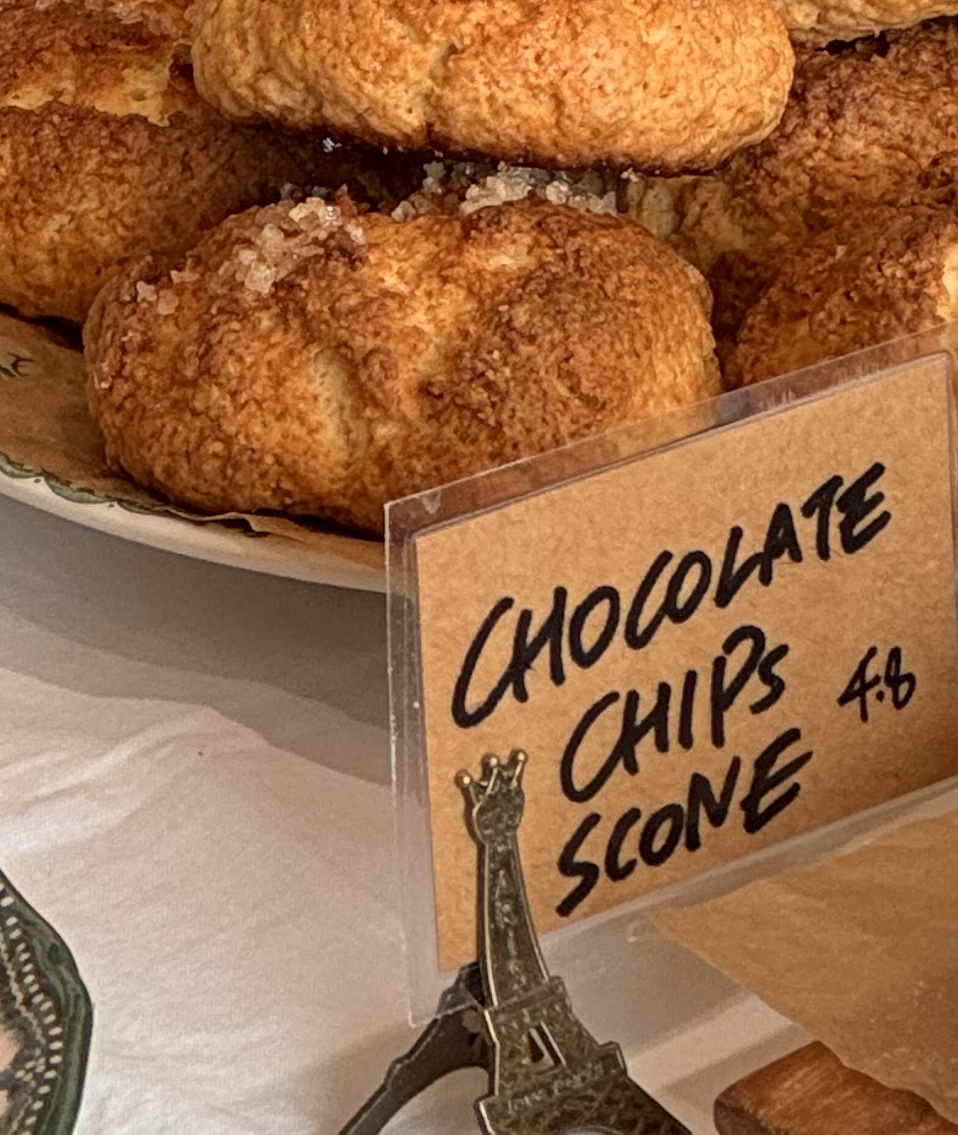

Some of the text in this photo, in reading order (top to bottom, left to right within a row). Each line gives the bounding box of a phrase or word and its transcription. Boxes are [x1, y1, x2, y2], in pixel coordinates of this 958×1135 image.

[451, 462, 892, 729] CHOCOLATE
[560, 625, 918, 803] CHIPS 4.8
[556, 728, 813, 918] SCONE
